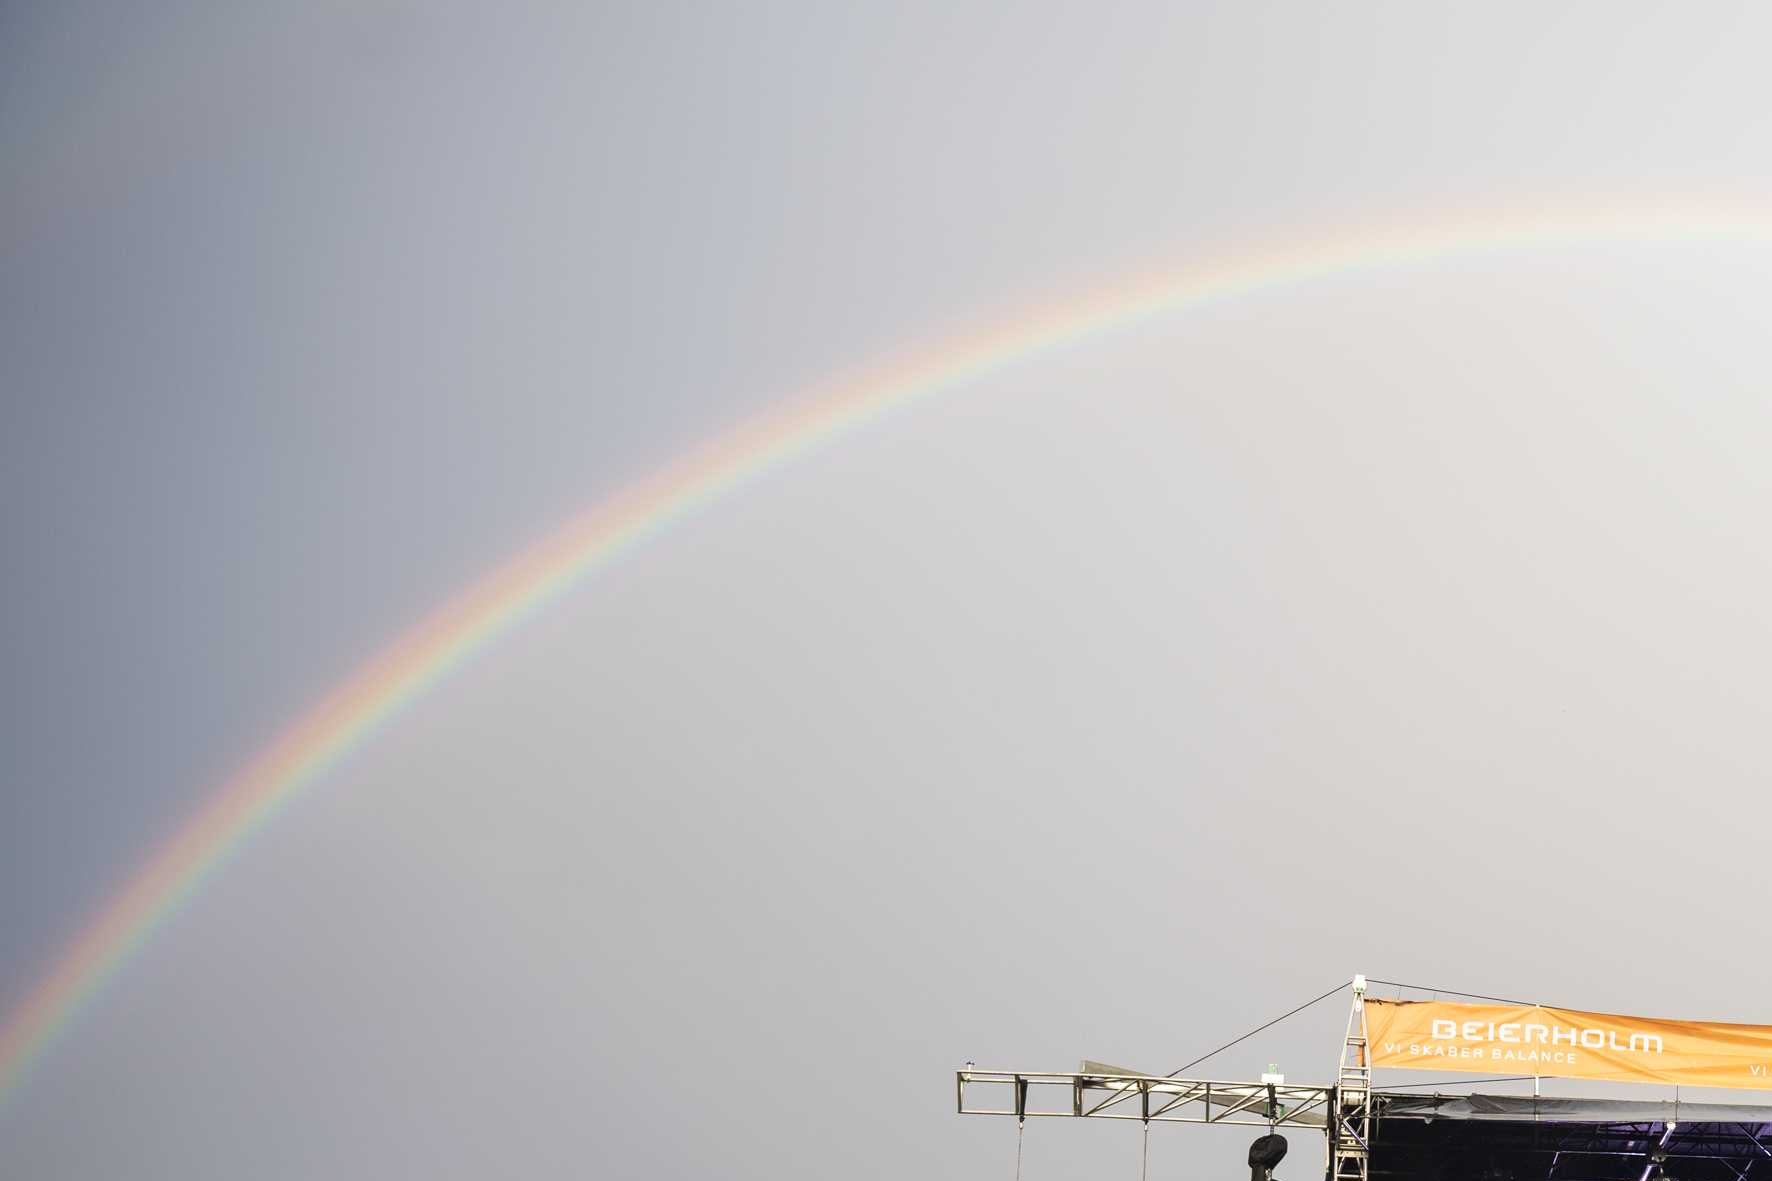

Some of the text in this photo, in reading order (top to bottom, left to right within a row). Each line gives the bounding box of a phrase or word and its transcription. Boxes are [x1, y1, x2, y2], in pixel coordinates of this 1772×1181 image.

[1432, 1019, 1663, 1053] BEIERHOLM
[1384, 1043, 1576, 1064] VI SKABER BALANCE
[1750, 1065, 1766, 1077] VI
